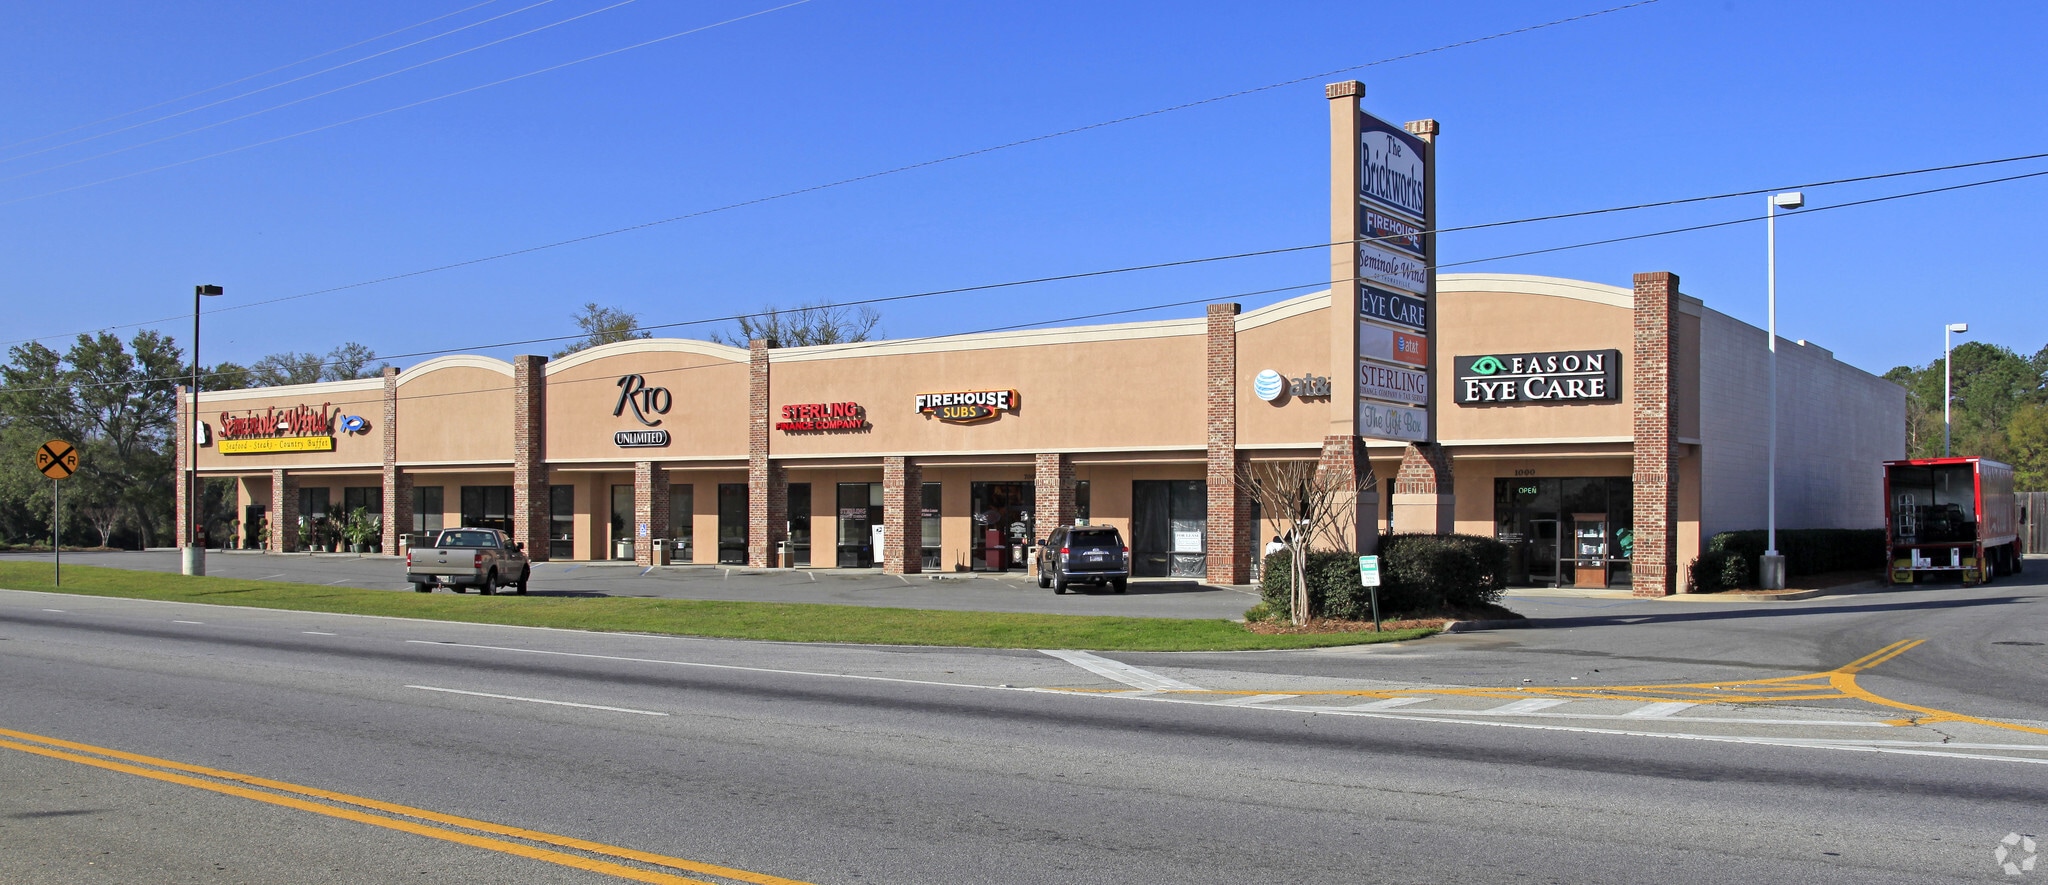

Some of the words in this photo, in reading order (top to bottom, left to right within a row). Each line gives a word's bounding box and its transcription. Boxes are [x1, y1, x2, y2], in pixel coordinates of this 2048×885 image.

[1386, 134, 1402, 158] The
[1362, 142, 1423, 212] Brickworks
[1366, 211, 1420, 250] FIREHOUSE
[1360, 249, 1399, 276] Seminole
[1400, 262, 1425, 284] Wind
[1361, 287, 1386, 317] EYE
[1390, 296, 1425, 326] CARE
[1405, 339, 1419, 354] at&t
[1511, 354, 1604, 375] EASON
[1289, 373, 1331, 396] at&
[1361, 364, 1425, 394] STERLING
[1465, 379, 1517, 401] EYE
[1523, 377, 1605, 400] CARE
[781, 401, 857, 419] STERLING
[915, 390, 1009, 414] FIREHOUSE
[943, 406, 977, 418] SUBS
[218, 405, 279, 438] Seminole
[285, 401, 331, 434] Wind
[776, 421, 814, 431] FINANCE
[815, 419, 863, 430] COMPANY
[1364, 405, 1383, 429] The
[1385, 408, 1402, 435] Gift
[1403, 411, 1422, 433] Box
[225, 442, 248, 451] Seafood
[279, 440, 305, 449] Country
[307, 438, 329, 448] Buffet
[617, 432, 663, 444] UNLIMITED
[39, 453, 49, 464] R
[67, 455, 76, 466] R
[1514, 469, 1536, 477] 1000
[1518, 486, 1537, 494] OPEN
